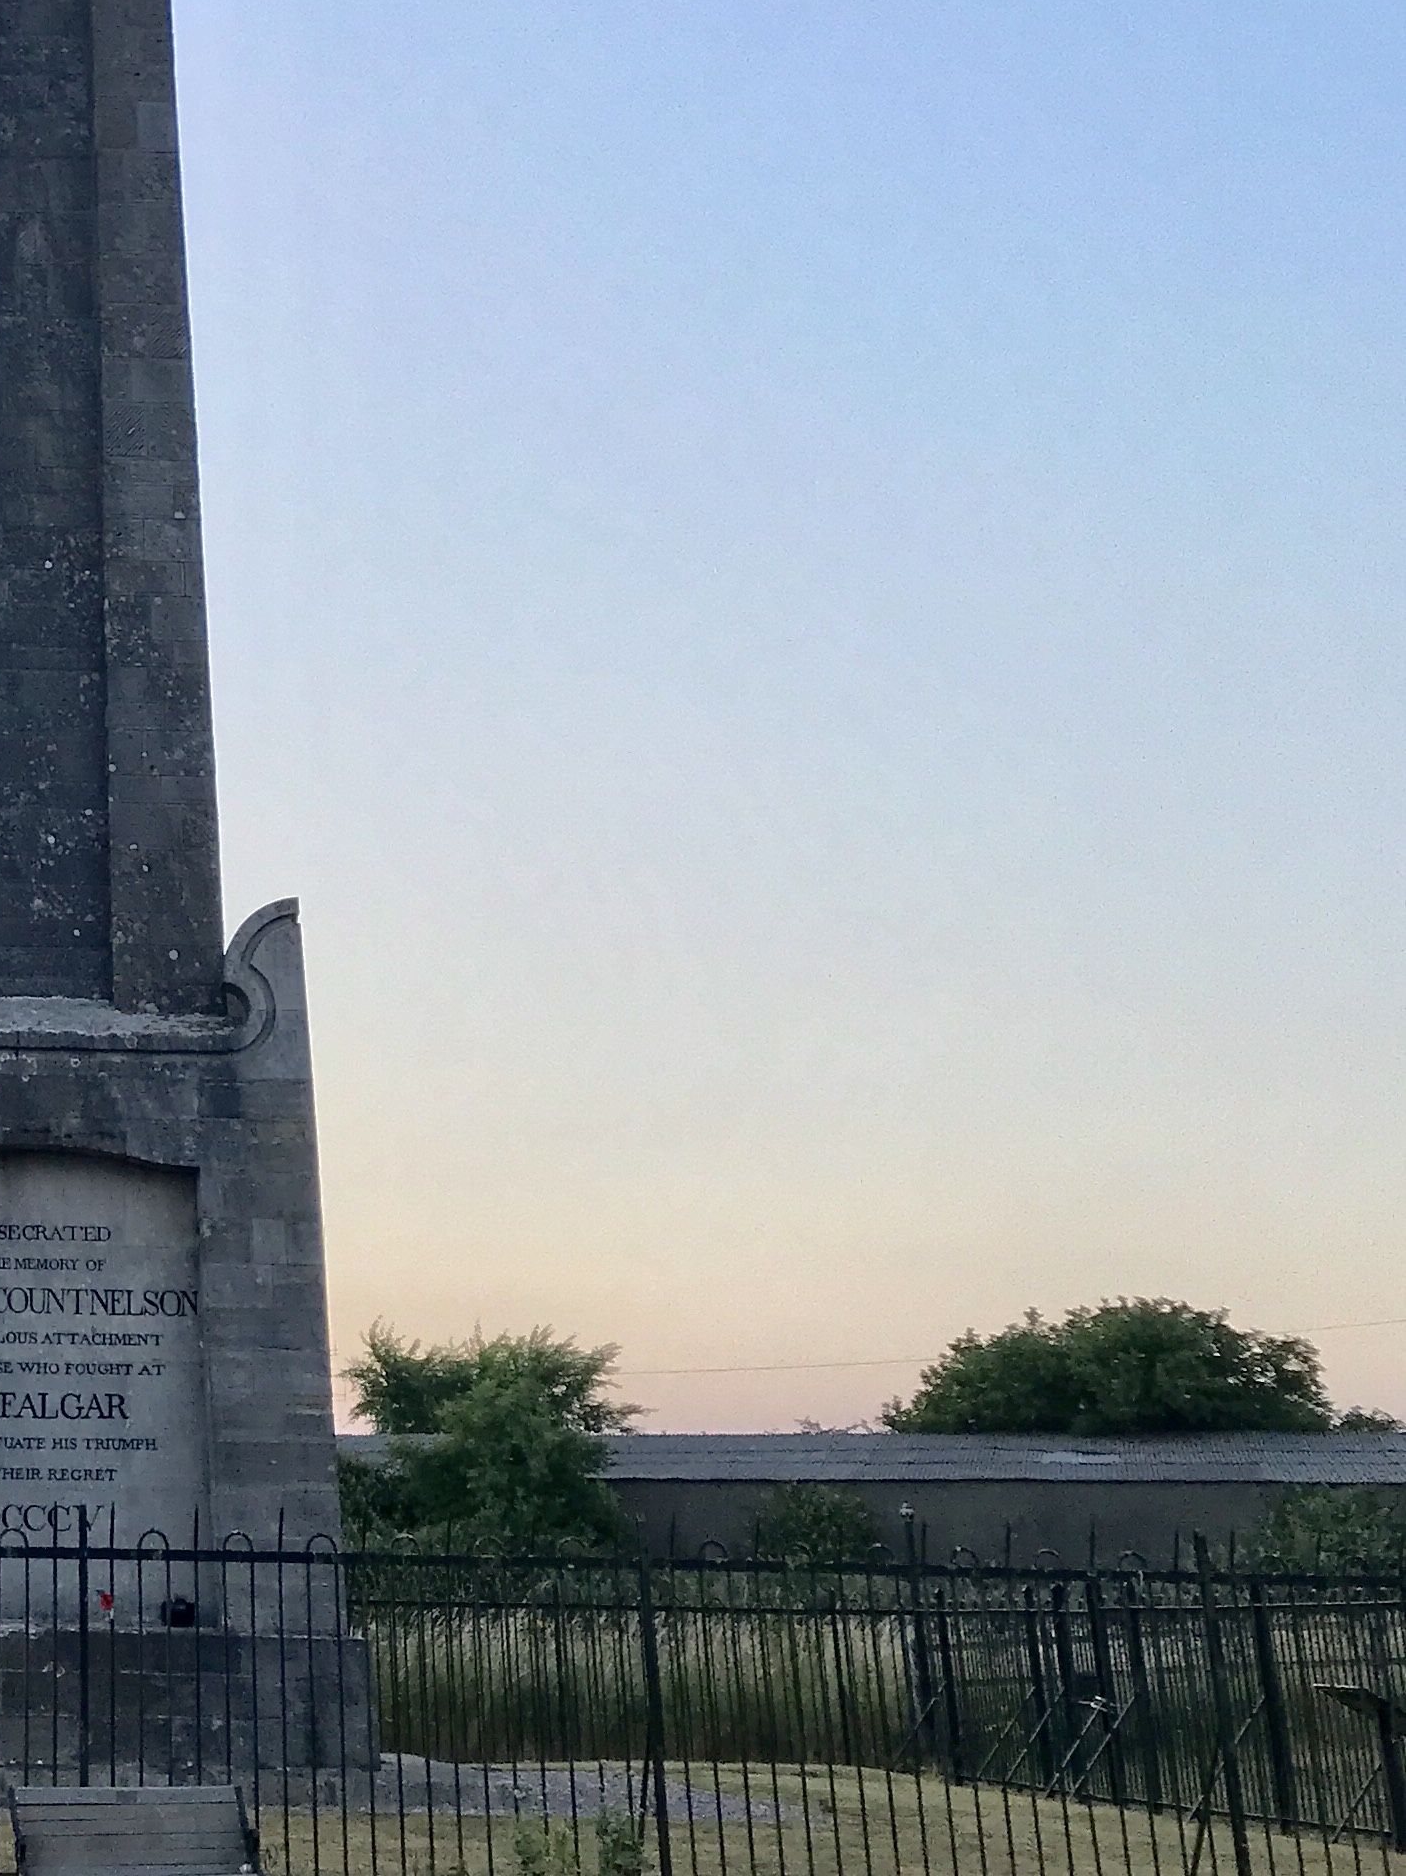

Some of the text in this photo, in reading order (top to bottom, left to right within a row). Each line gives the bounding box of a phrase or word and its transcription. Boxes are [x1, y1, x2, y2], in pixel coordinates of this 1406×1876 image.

[14, 1257, 80, 1271] MEMORY
[86, 1259, 106, 1272] OF
[91, 1289, 199, 1316] NELSON
[40, 1331, 164, 1346] ATTACHMENT
[18, 1361, 60, 1375] WHO
[65, 1362, 133, 1376] FOUGHT
[138, 1364, 166, 1376] AT
[52, 1437, 77, 1450] HIS
[85, 1437, 157, 1451] TRIUMPH
[48, 1468, 117, 1482] REGRET
